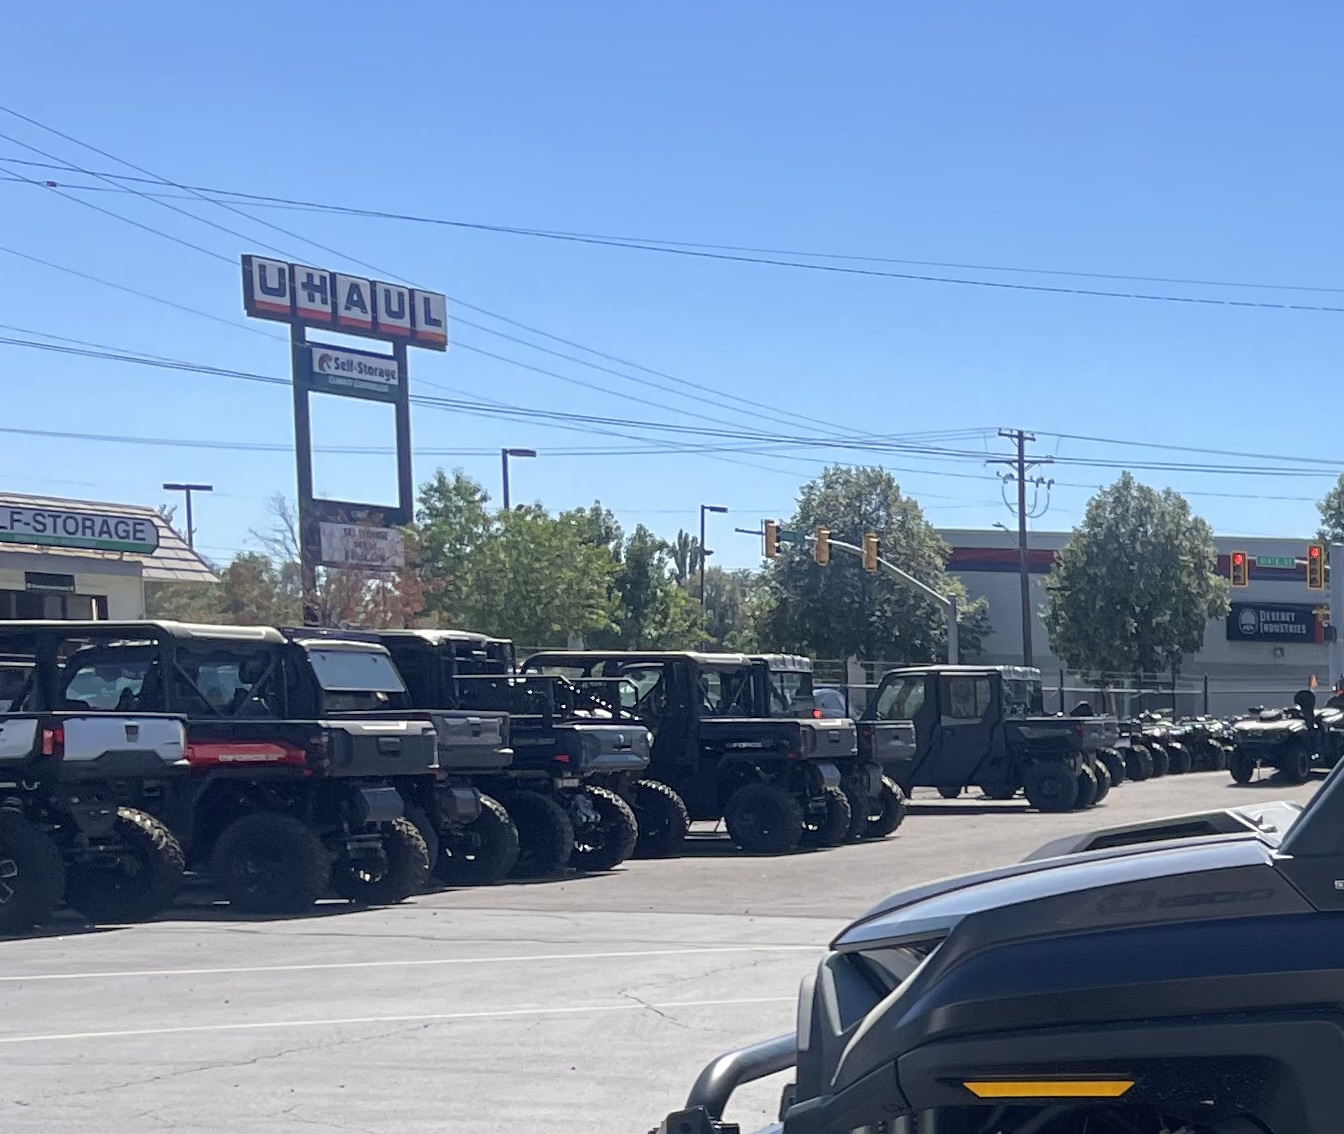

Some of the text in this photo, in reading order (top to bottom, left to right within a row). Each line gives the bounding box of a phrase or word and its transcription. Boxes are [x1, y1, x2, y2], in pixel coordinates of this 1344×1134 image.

[334, 357, 397, 381] Self-Storage
[1259, 610, 1296, 622] DESERET
[1259, 622, 1307, 634] INDUSTRIES
